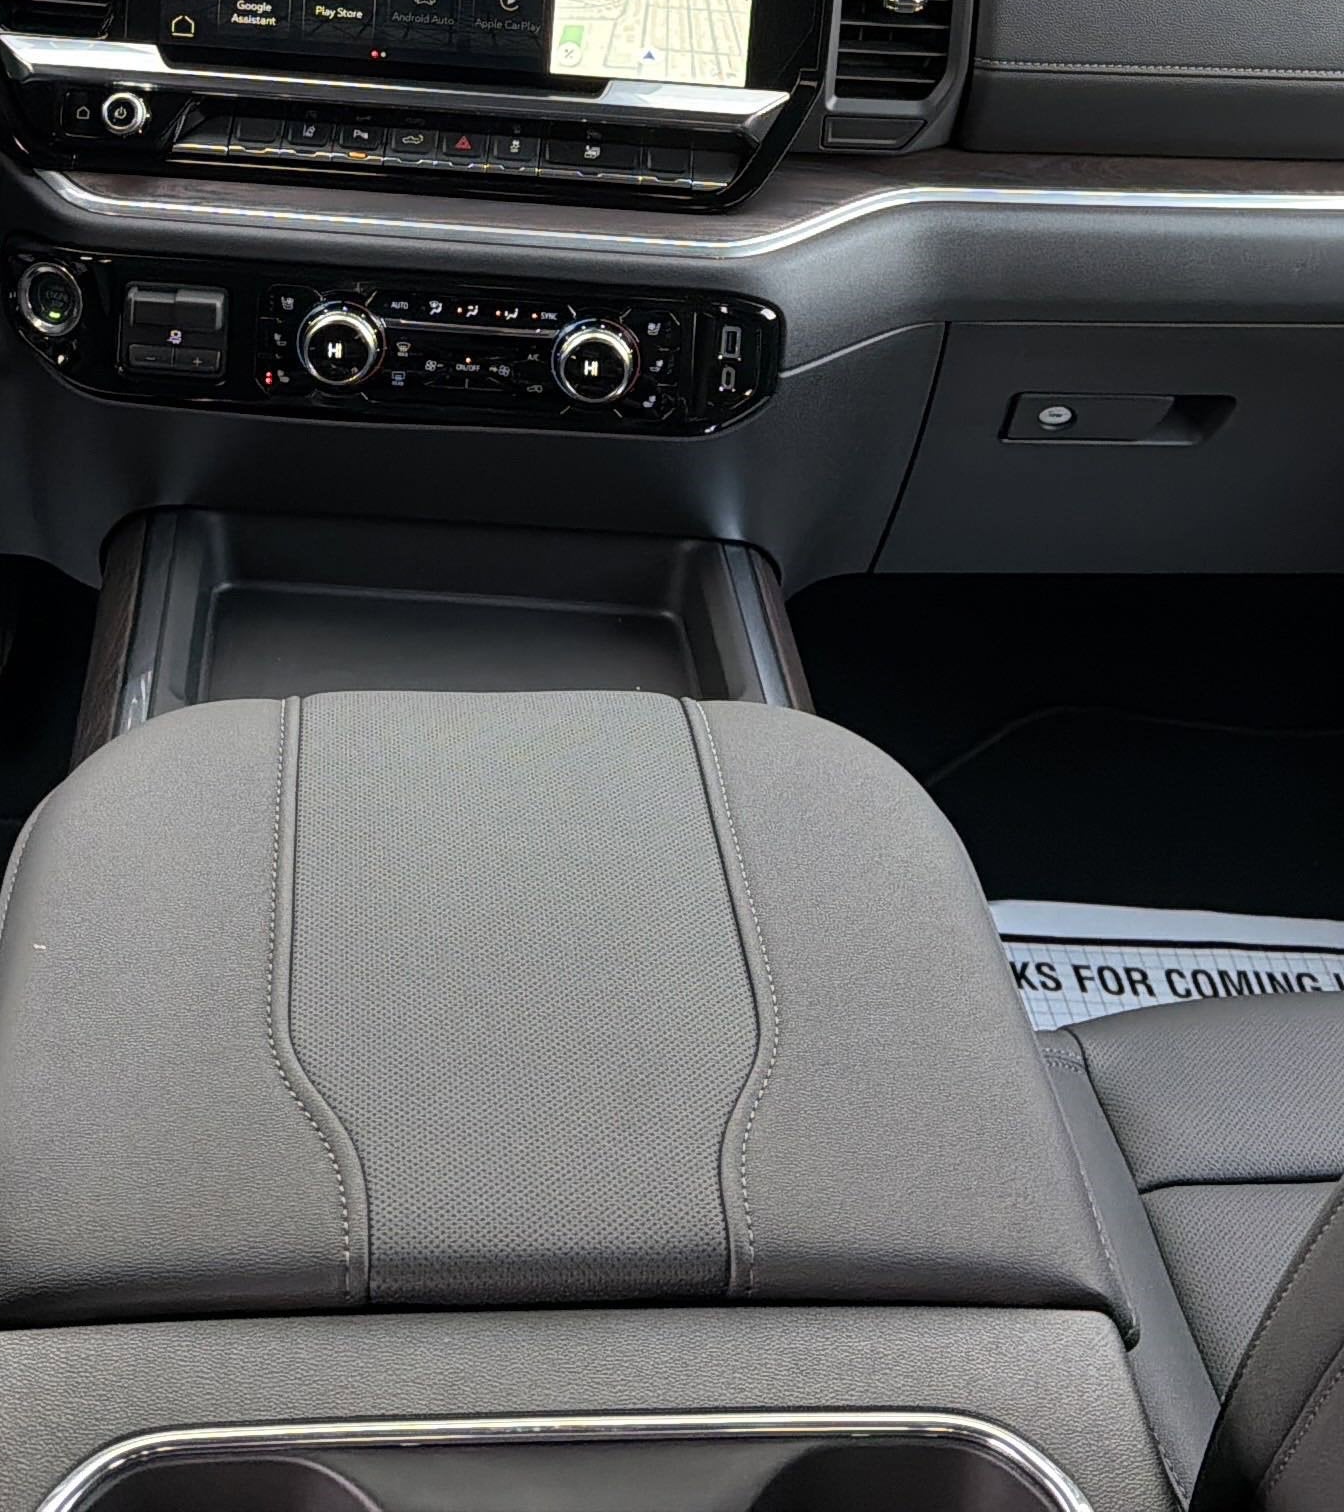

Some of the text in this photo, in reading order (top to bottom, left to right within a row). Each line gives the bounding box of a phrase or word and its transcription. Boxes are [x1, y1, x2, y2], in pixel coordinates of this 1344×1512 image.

[236, 0, 273, 14] Google
[315, 5, 364, 19] Play Store
[230, 13, 277, 26] Assistant
[392, 11, 455, 25] Android Auto
[475, 17, 542, 33] Apple CarPlay
[391, 300, 409, 310] AUTO
[540, 311, 558, 321] SYNC
[327, 342, 343, 359] HI
[584, 359, 599, 377] HI
[1071, 963, 1157, 999] FOR
[1164, 966, 1322, 999] COMING
